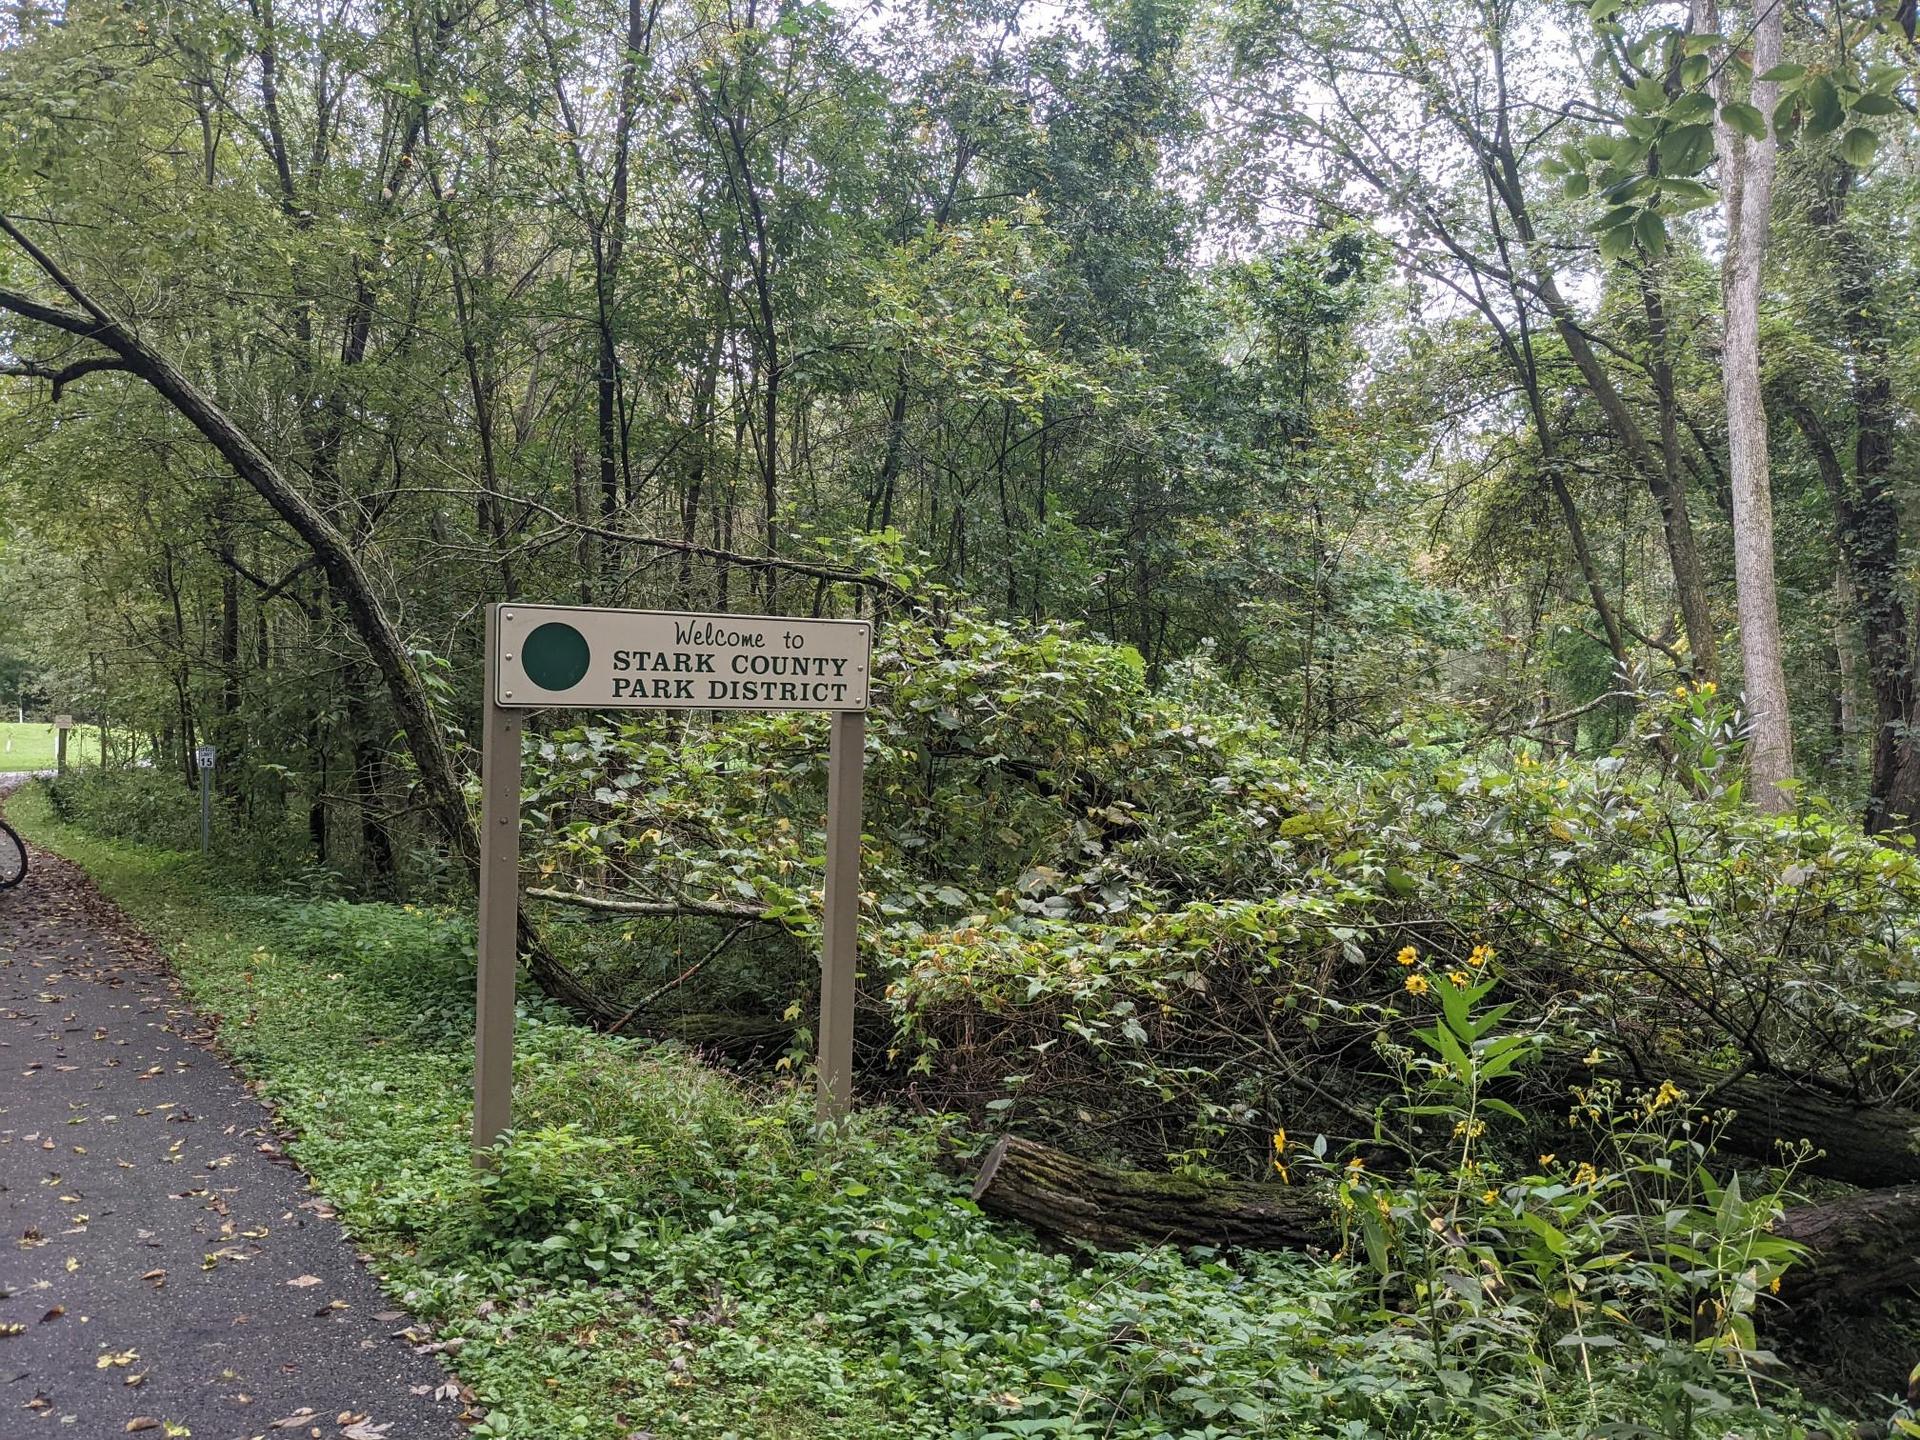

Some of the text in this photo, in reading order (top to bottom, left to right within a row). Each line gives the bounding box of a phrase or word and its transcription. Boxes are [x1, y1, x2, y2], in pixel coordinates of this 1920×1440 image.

[674, 620, 804, 649] Welcome to
[613, 650, 848, 677] STARK COUNTY
[612, 677, 847, 702] PARK DISTRICT
[201, 757, 213, 767] 15
